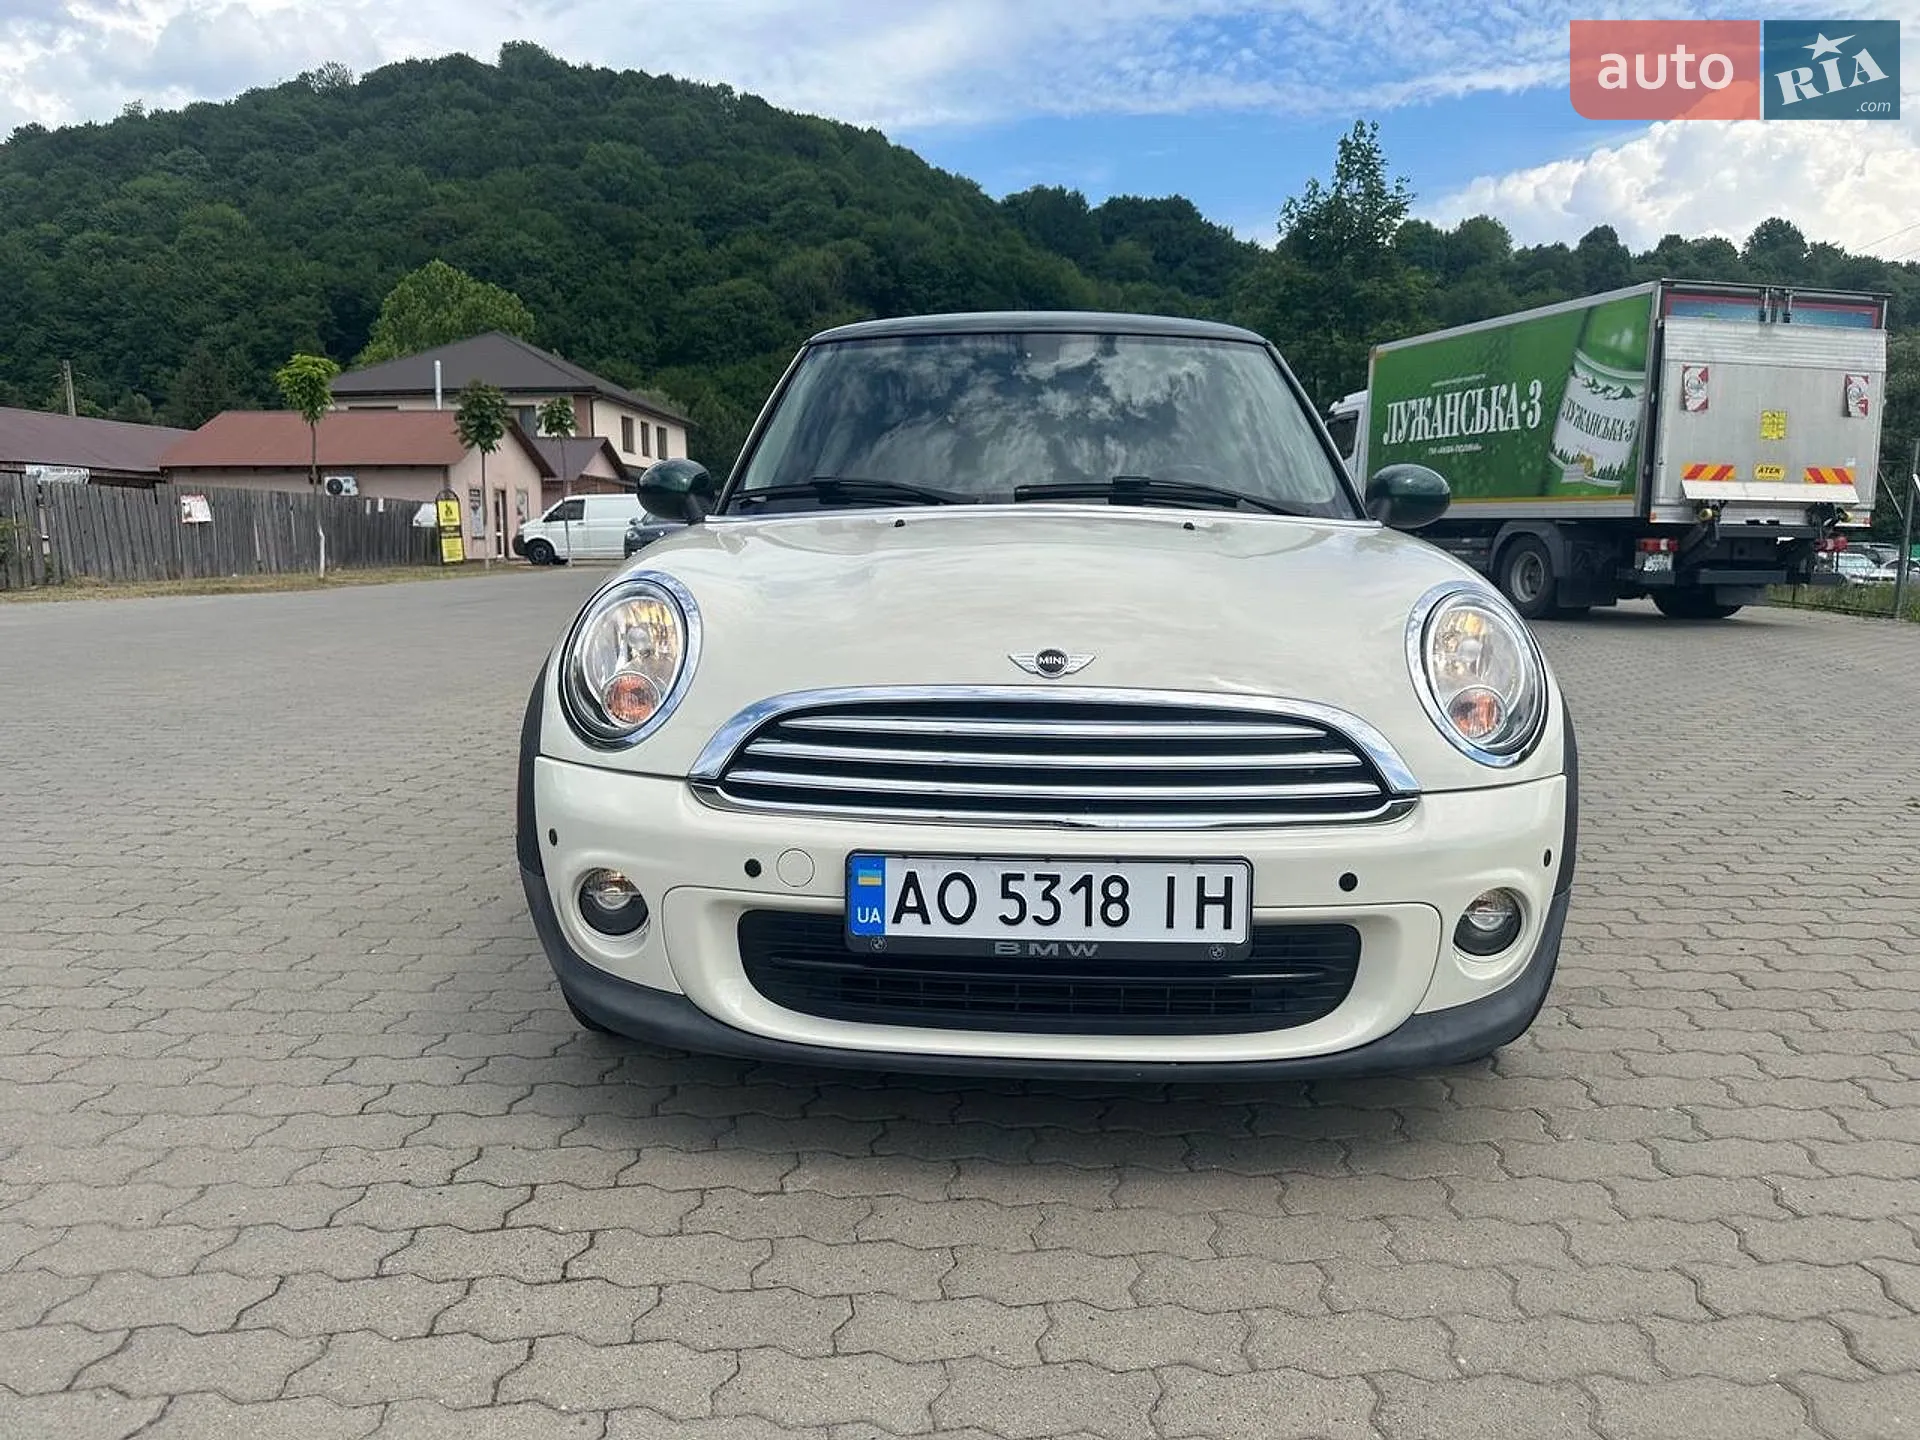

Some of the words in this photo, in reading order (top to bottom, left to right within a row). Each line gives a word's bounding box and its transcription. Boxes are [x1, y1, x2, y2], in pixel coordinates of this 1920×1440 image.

[1039, 655, 1065, 666] MINI
[892, 870, 978, 926] AO
[999, 873, 1130, 928] 5318
[1165, 875, 1234, 930] IH
[857, 906, 882, 924] UA
[994, 941, 1099, 958] BMW
